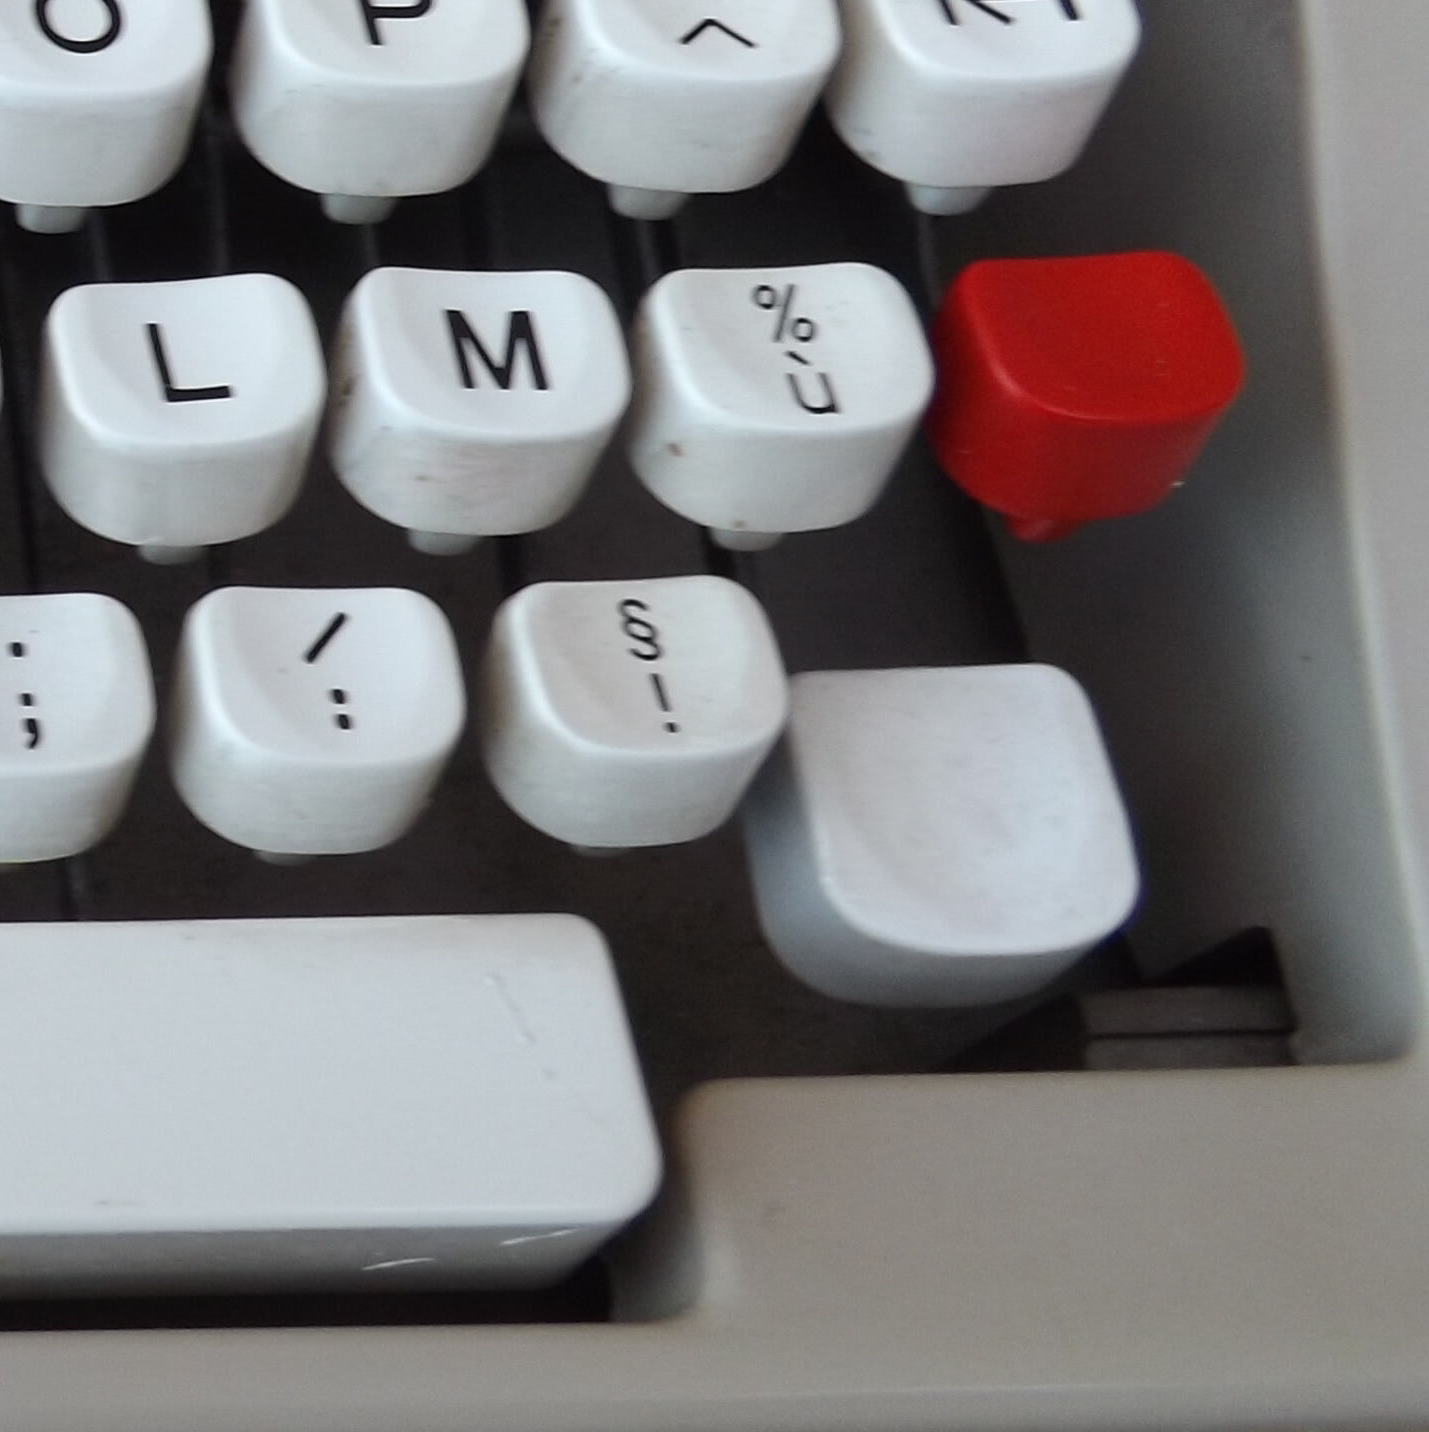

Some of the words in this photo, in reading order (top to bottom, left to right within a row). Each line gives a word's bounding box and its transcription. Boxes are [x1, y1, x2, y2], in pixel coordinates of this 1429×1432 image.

[751, 283, 817, 344] %
[144, 321, 234, 404] L
[442, 308, 551, 392] M
[784, 349, 841, 416] ù
[302, 611, 349, 665] /
[616, 597, 663, 663] §
[18, 691, 43, 751] ;
[328, 687, 354, 732] :
[648, 672, 680, 735] !
